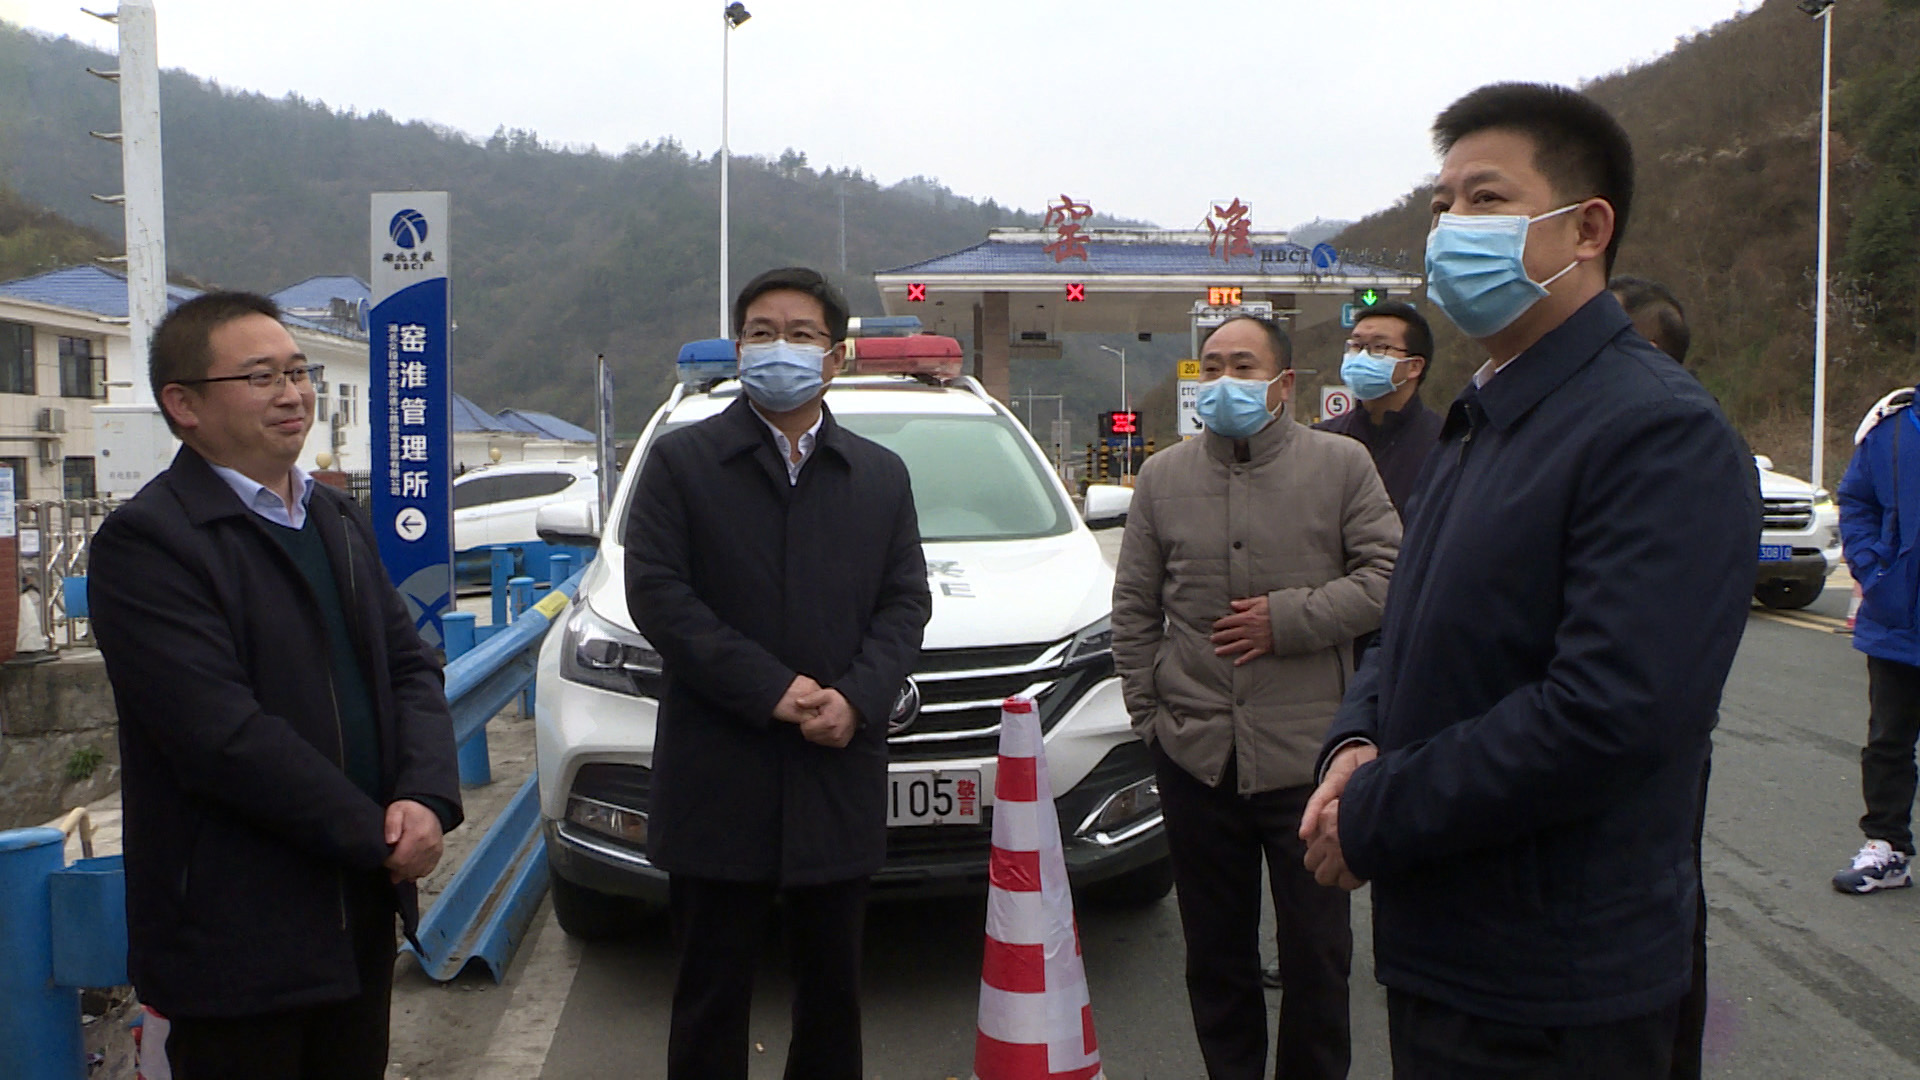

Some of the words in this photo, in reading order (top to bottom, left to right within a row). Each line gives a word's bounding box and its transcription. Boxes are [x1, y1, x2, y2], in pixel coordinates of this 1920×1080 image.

[1260, 248, 1308, 262] HBCI
[1209, 287, 1242, 305] ETC
[1184, 363, 1199, 374] 20
[1181, 387, 1198, 396] ETC
[400, 323, 429, 498] 窑淮管理所
[1333, 397, 1343, 412] 5
